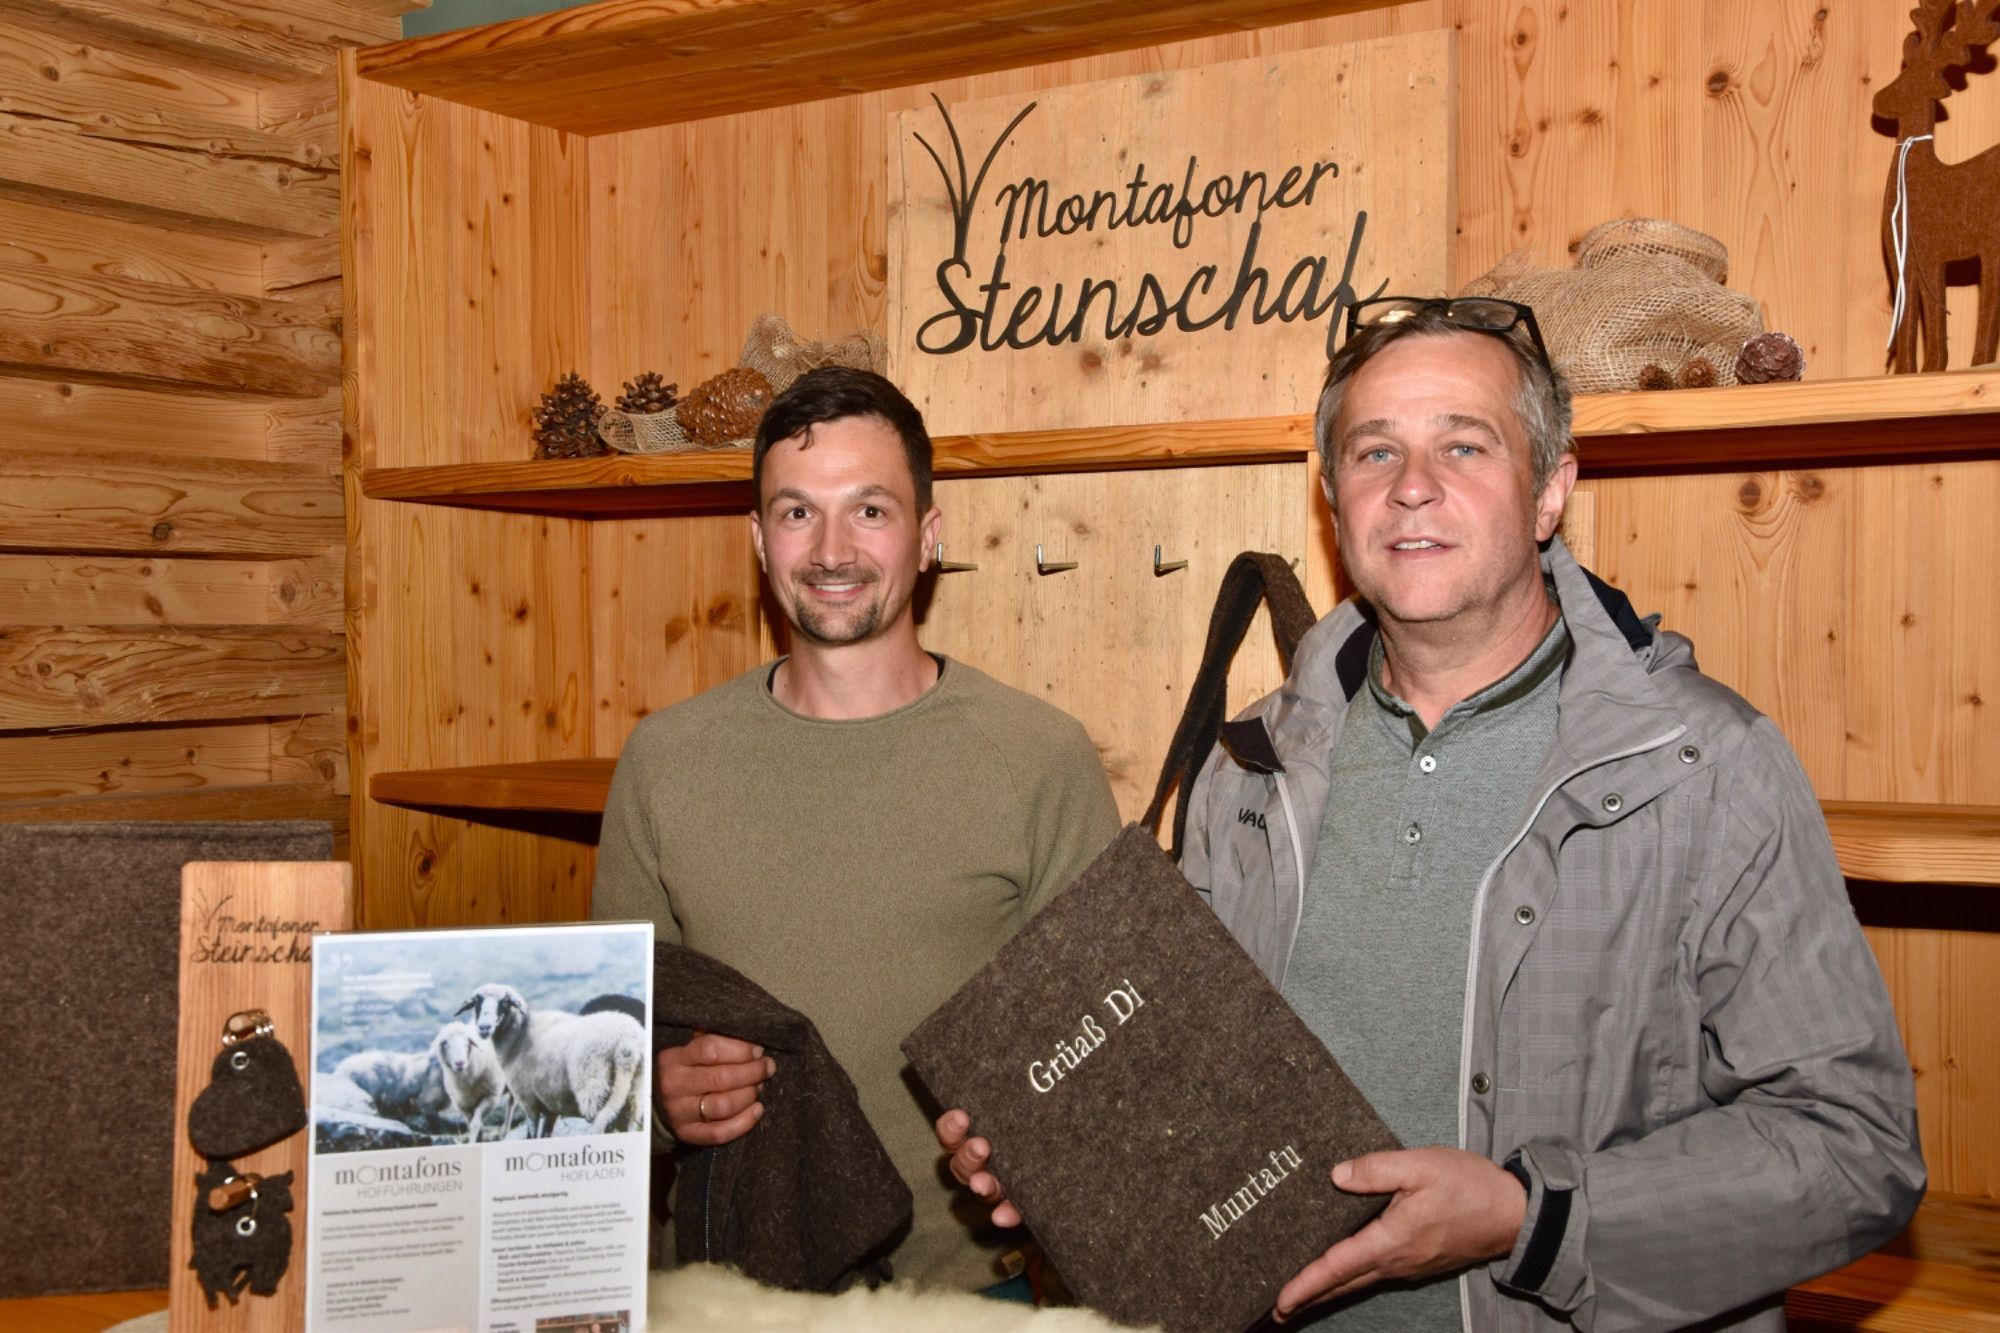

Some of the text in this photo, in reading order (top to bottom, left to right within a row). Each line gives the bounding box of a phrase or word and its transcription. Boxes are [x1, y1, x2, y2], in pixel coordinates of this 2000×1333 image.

[995, 155, 1339, 249] Montafoner
[916, 211, 1389, 361] Steinschaf
[218, 915, 320, 941] Montafoner
[190, 934, 312, 964] Steinscha
[1028, 978, 1145, 1093] Grüaß Di
[335, 1156, 462, 1186] montafons
[505, 1144, 625, 1172] montafons
[357, 1179, 463, 1199] HOFFÜHRUNGEN
[561, 1167, 625, 1183] HOFLADEN
[1199, 1145, 1303, 1240] Muntafu
